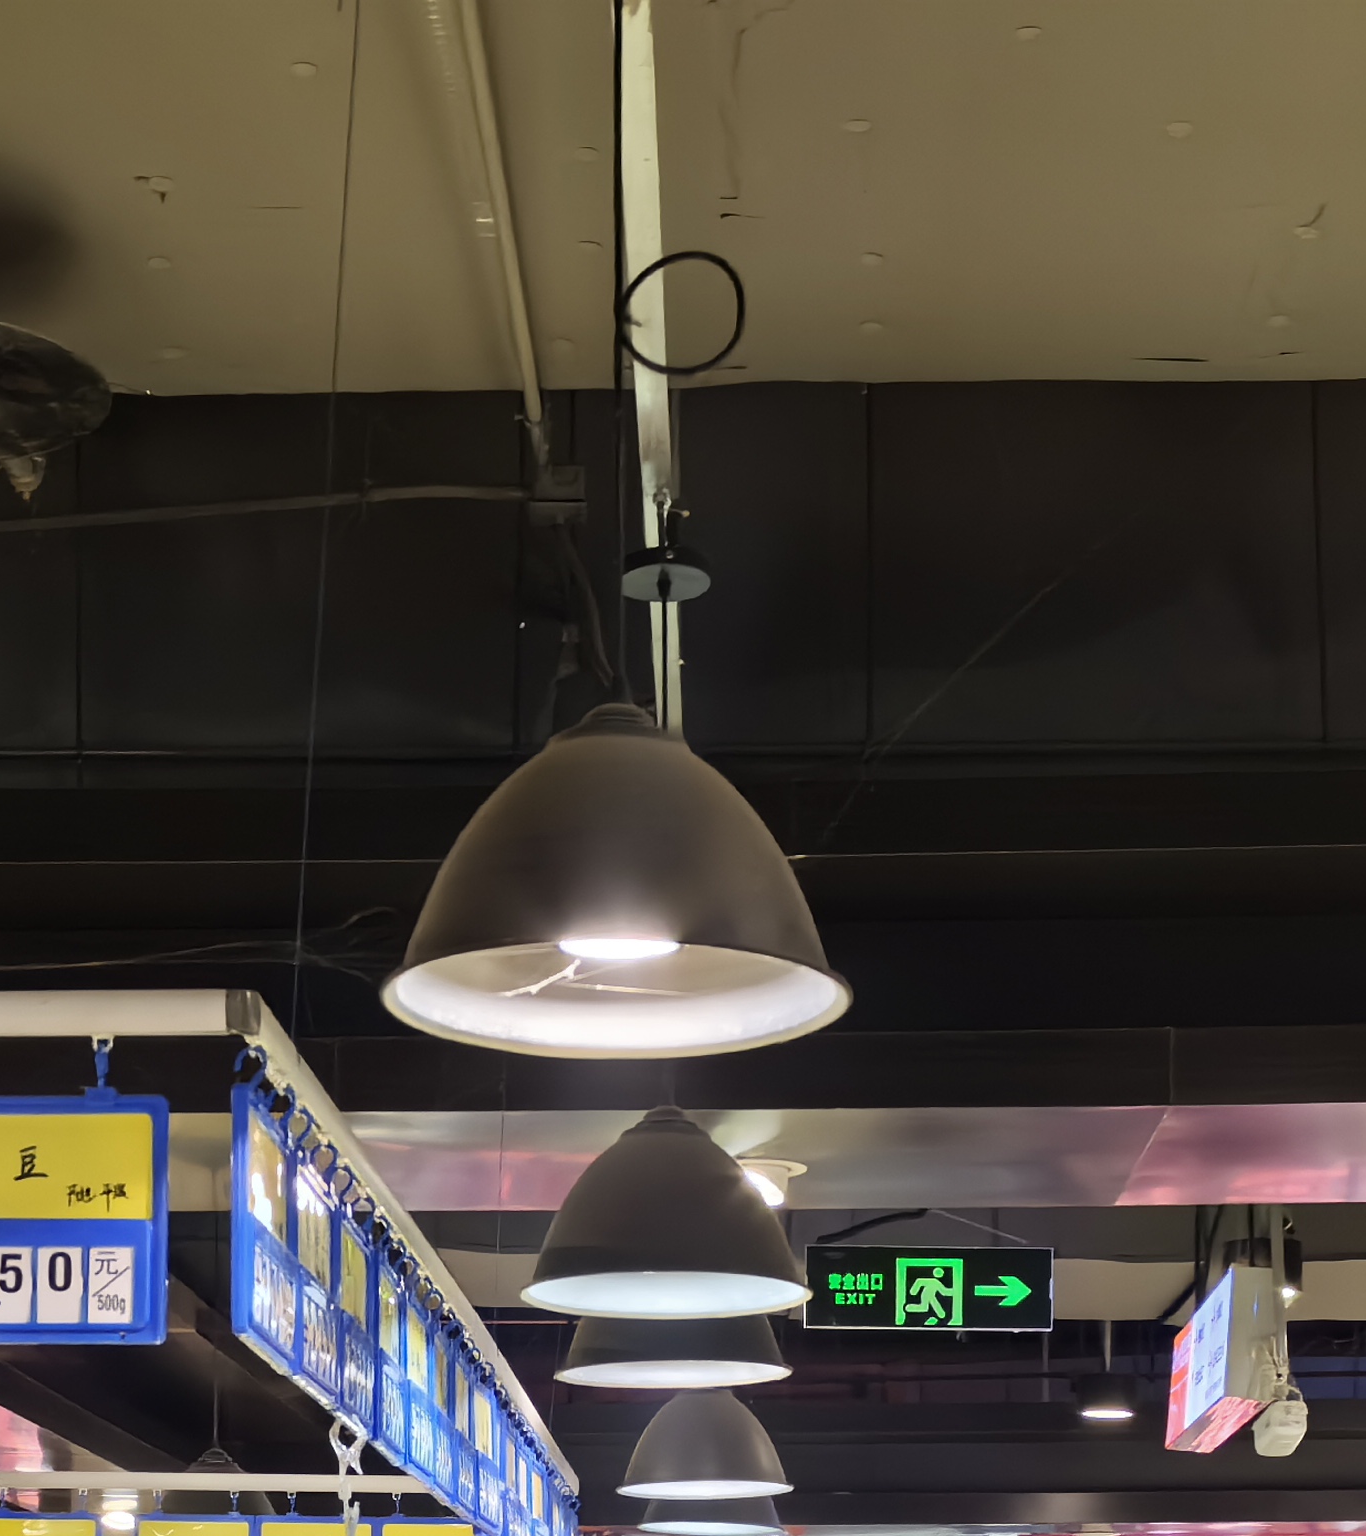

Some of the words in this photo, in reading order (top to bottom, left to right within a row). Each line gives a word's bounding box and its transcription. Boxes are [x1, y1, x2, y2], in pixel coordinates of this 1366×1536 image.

[828, 1273, 883, 1290] 安全出口
[835, 1293, 876, 1305] EXIT
